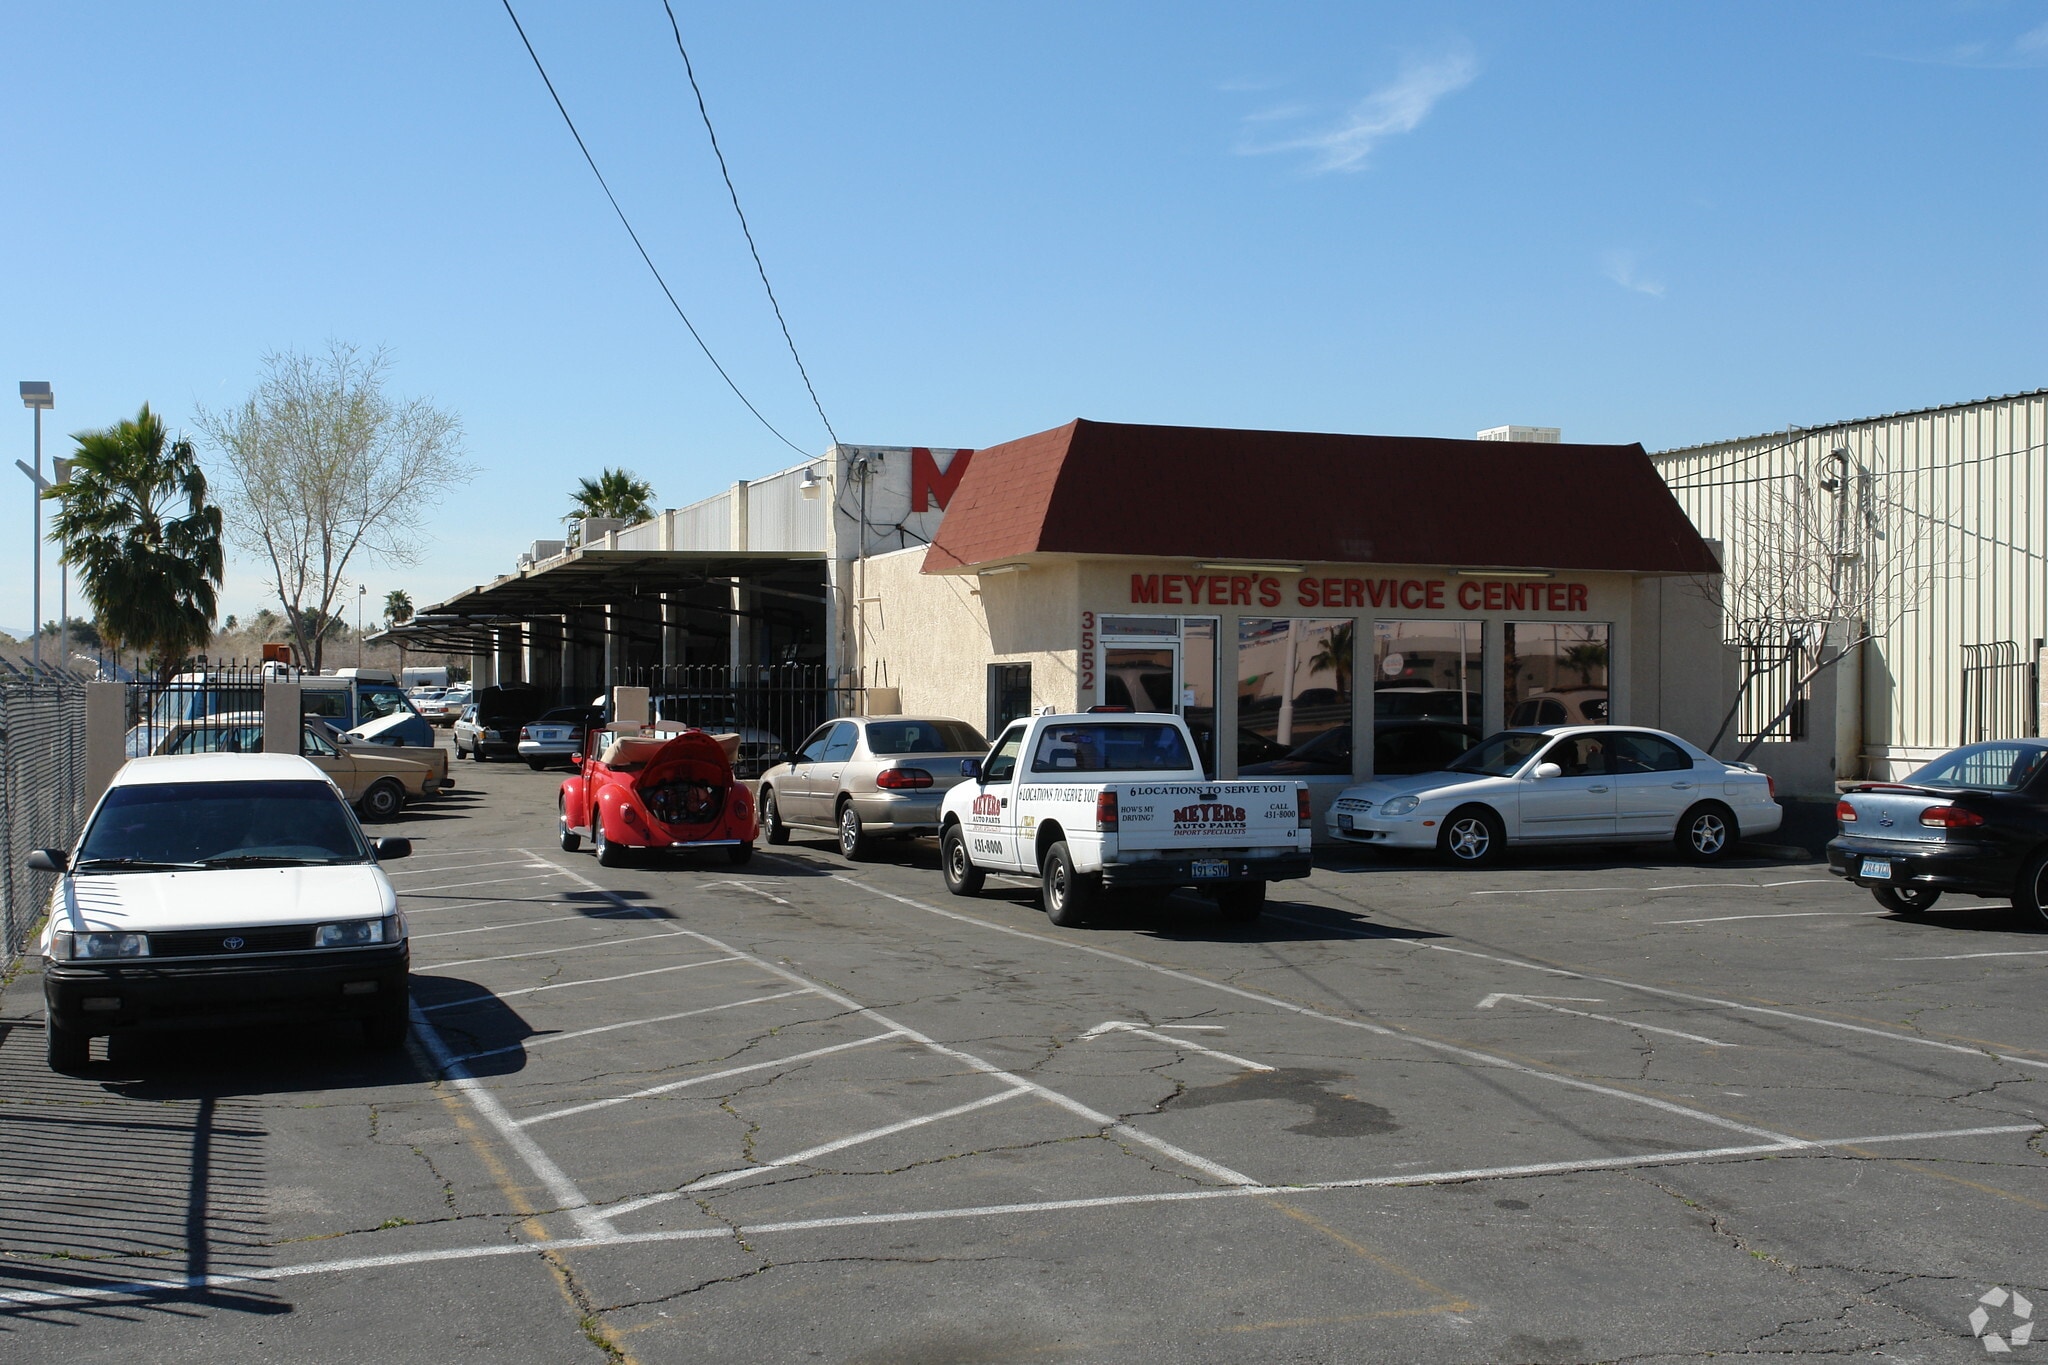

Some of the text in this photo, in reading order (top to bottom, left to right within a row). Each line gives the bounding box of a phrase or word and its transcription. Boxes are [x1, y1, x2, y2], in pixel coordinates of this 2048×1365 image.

[912, 447, 974, 512] M
[1131, 573, 1588, 611] MEYER'S SERVICE CENTER
[1022, 788, 1053, 801] LOCATIONS
[1053, 788, 1062, 801] TO
[1062, 788, 1083, 802] SERVE
[1083, 788, 1098, 802] YOU
[1130, 785, 1286, 796] 6 LOCATIONS TO SERVE YOU
[973, 794, 1000, 816] MEYERS
[1143, 805, 1154, 813] MY
[1122, 814, 1154, 822] DRIVING?
[1173, 803, 1246, 823] MEYERS
[1264, 811, 1296, 819] 431-8000
[986, 816, 1000, 824] PARTS
[1203, 828, 1246, 836] SPECIALISTS
[974, 838, 1003, 855] 431-8000
